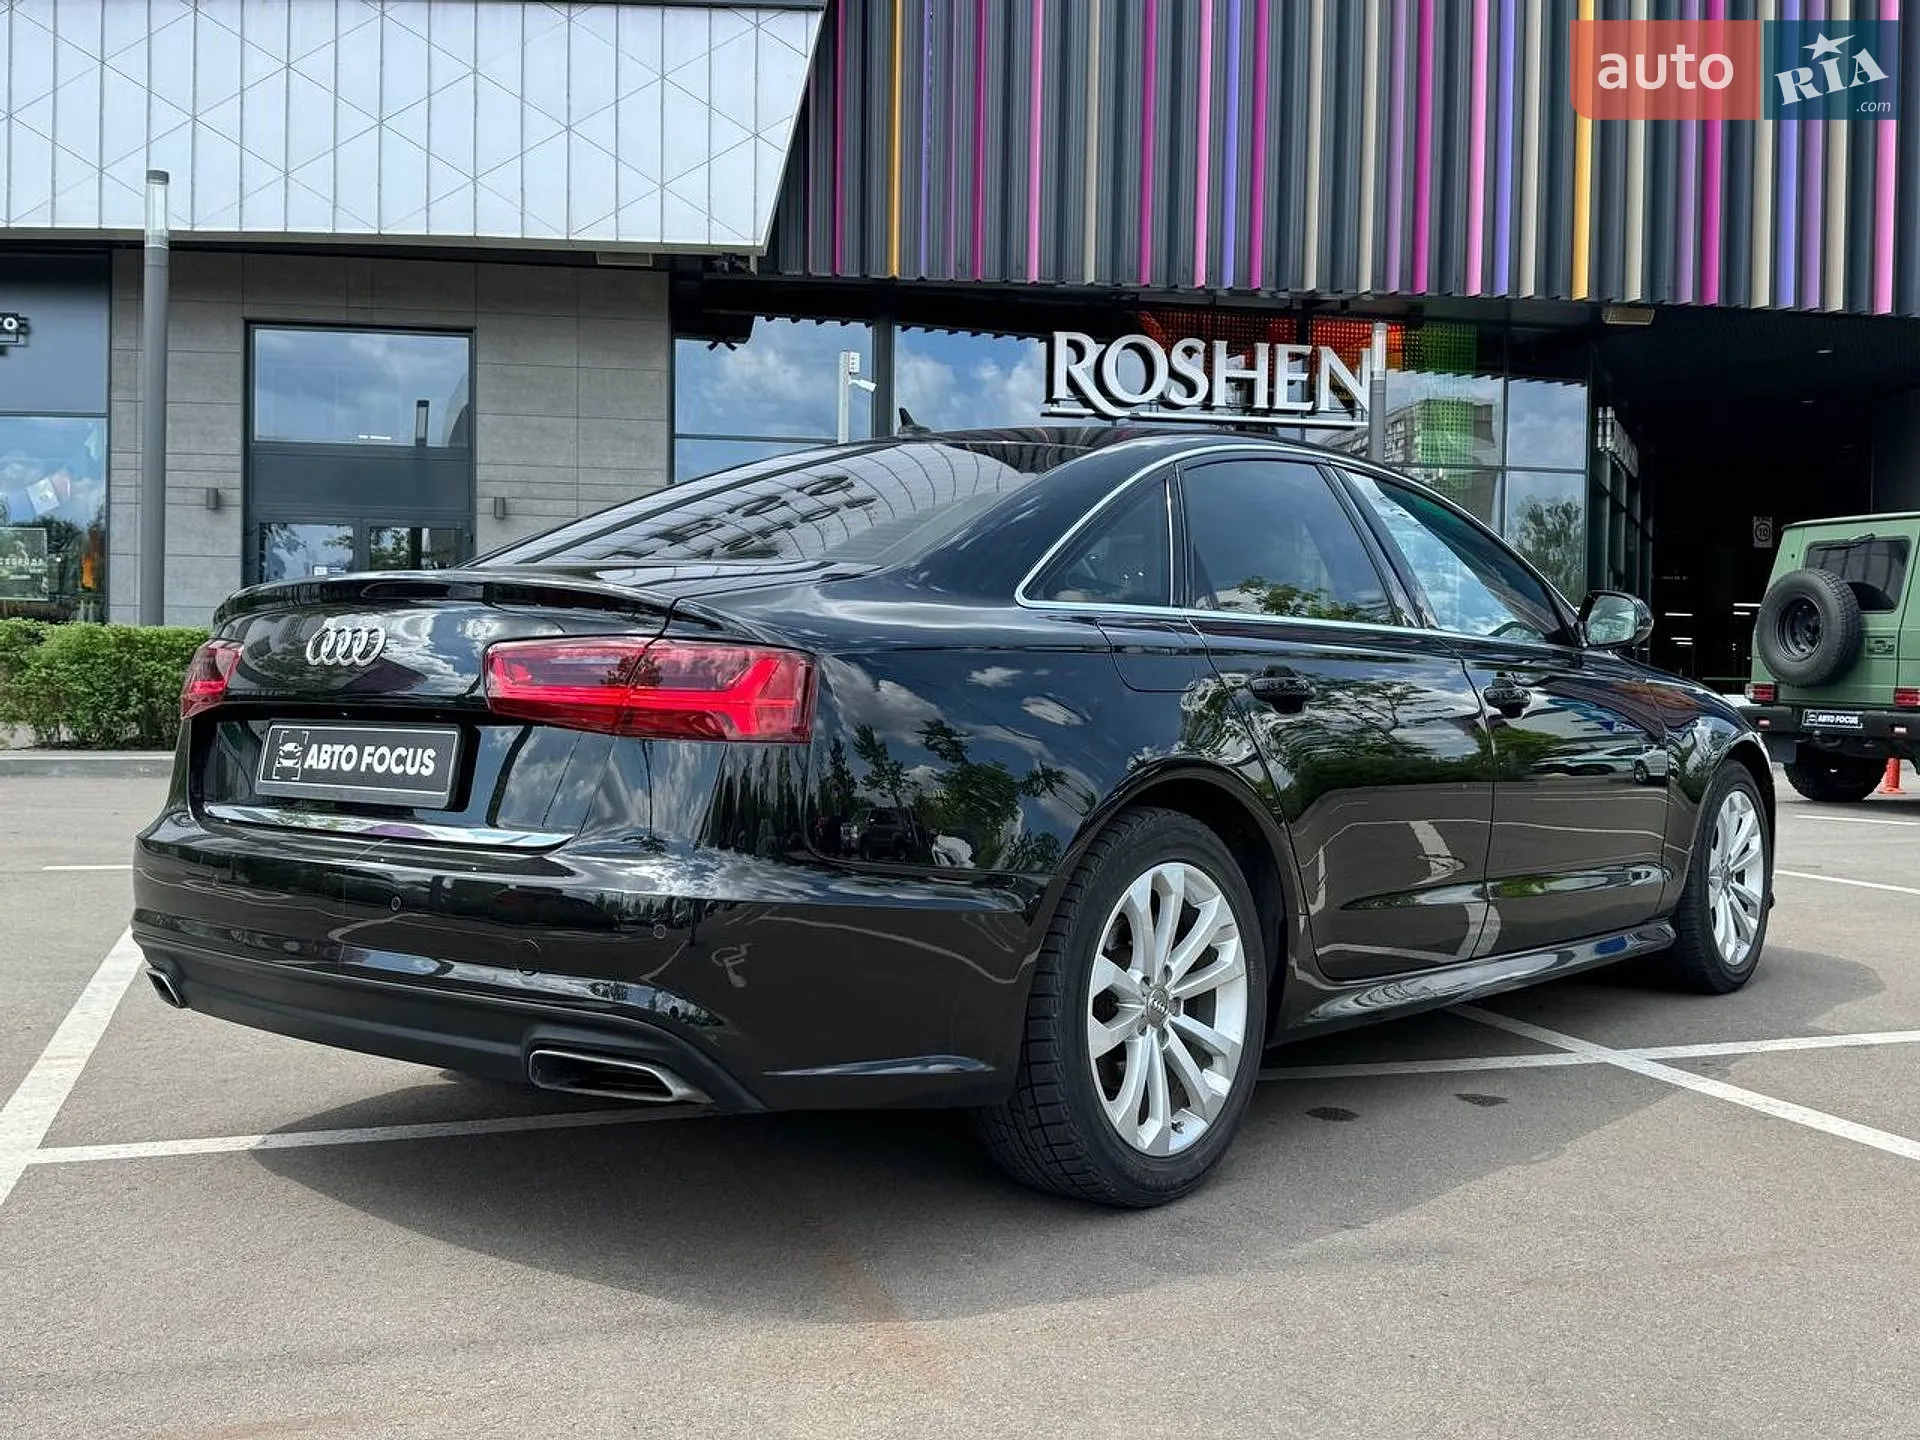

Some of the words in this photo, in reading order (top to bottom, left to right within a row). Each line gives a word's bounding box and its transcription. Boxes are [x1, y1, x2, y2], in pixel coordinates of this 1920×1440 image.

[1052, 331, 1370, 417] ROSHEN
[1835, 715, 1858, 725] FOCUS
[361, 746, 436, 776] FOCUS
